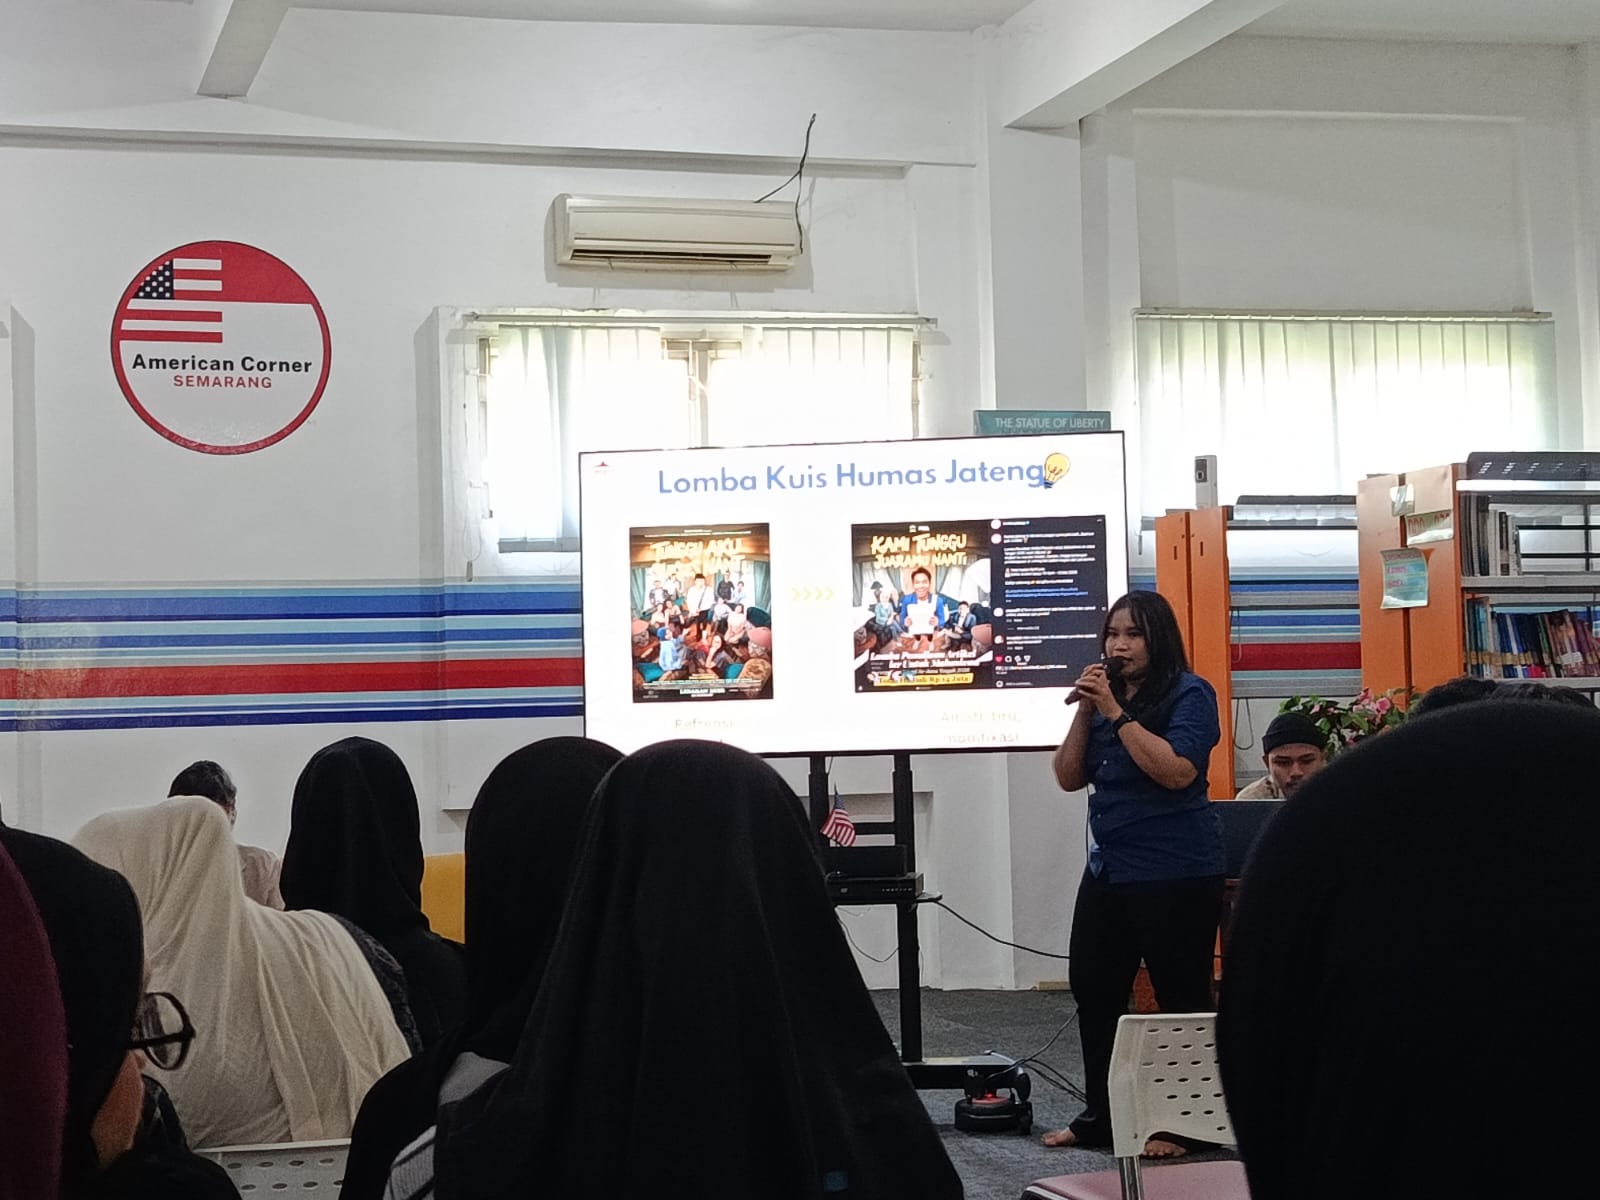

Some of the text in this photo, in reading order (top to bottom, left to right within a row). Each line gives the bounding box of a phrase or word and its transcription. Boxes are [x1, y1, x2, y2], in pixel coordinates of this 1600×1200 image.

[132, 354, 313, 373] American Corner
[173, 375, 272, 389] SEMARANG
[995, 417, 1105, 428] THE STATUE OF LIBERTY
[658, 457, 1046, 495] Lomba Kuis Humas Jateng
[871, 533, 967, 554] KAMI TUNGGU
